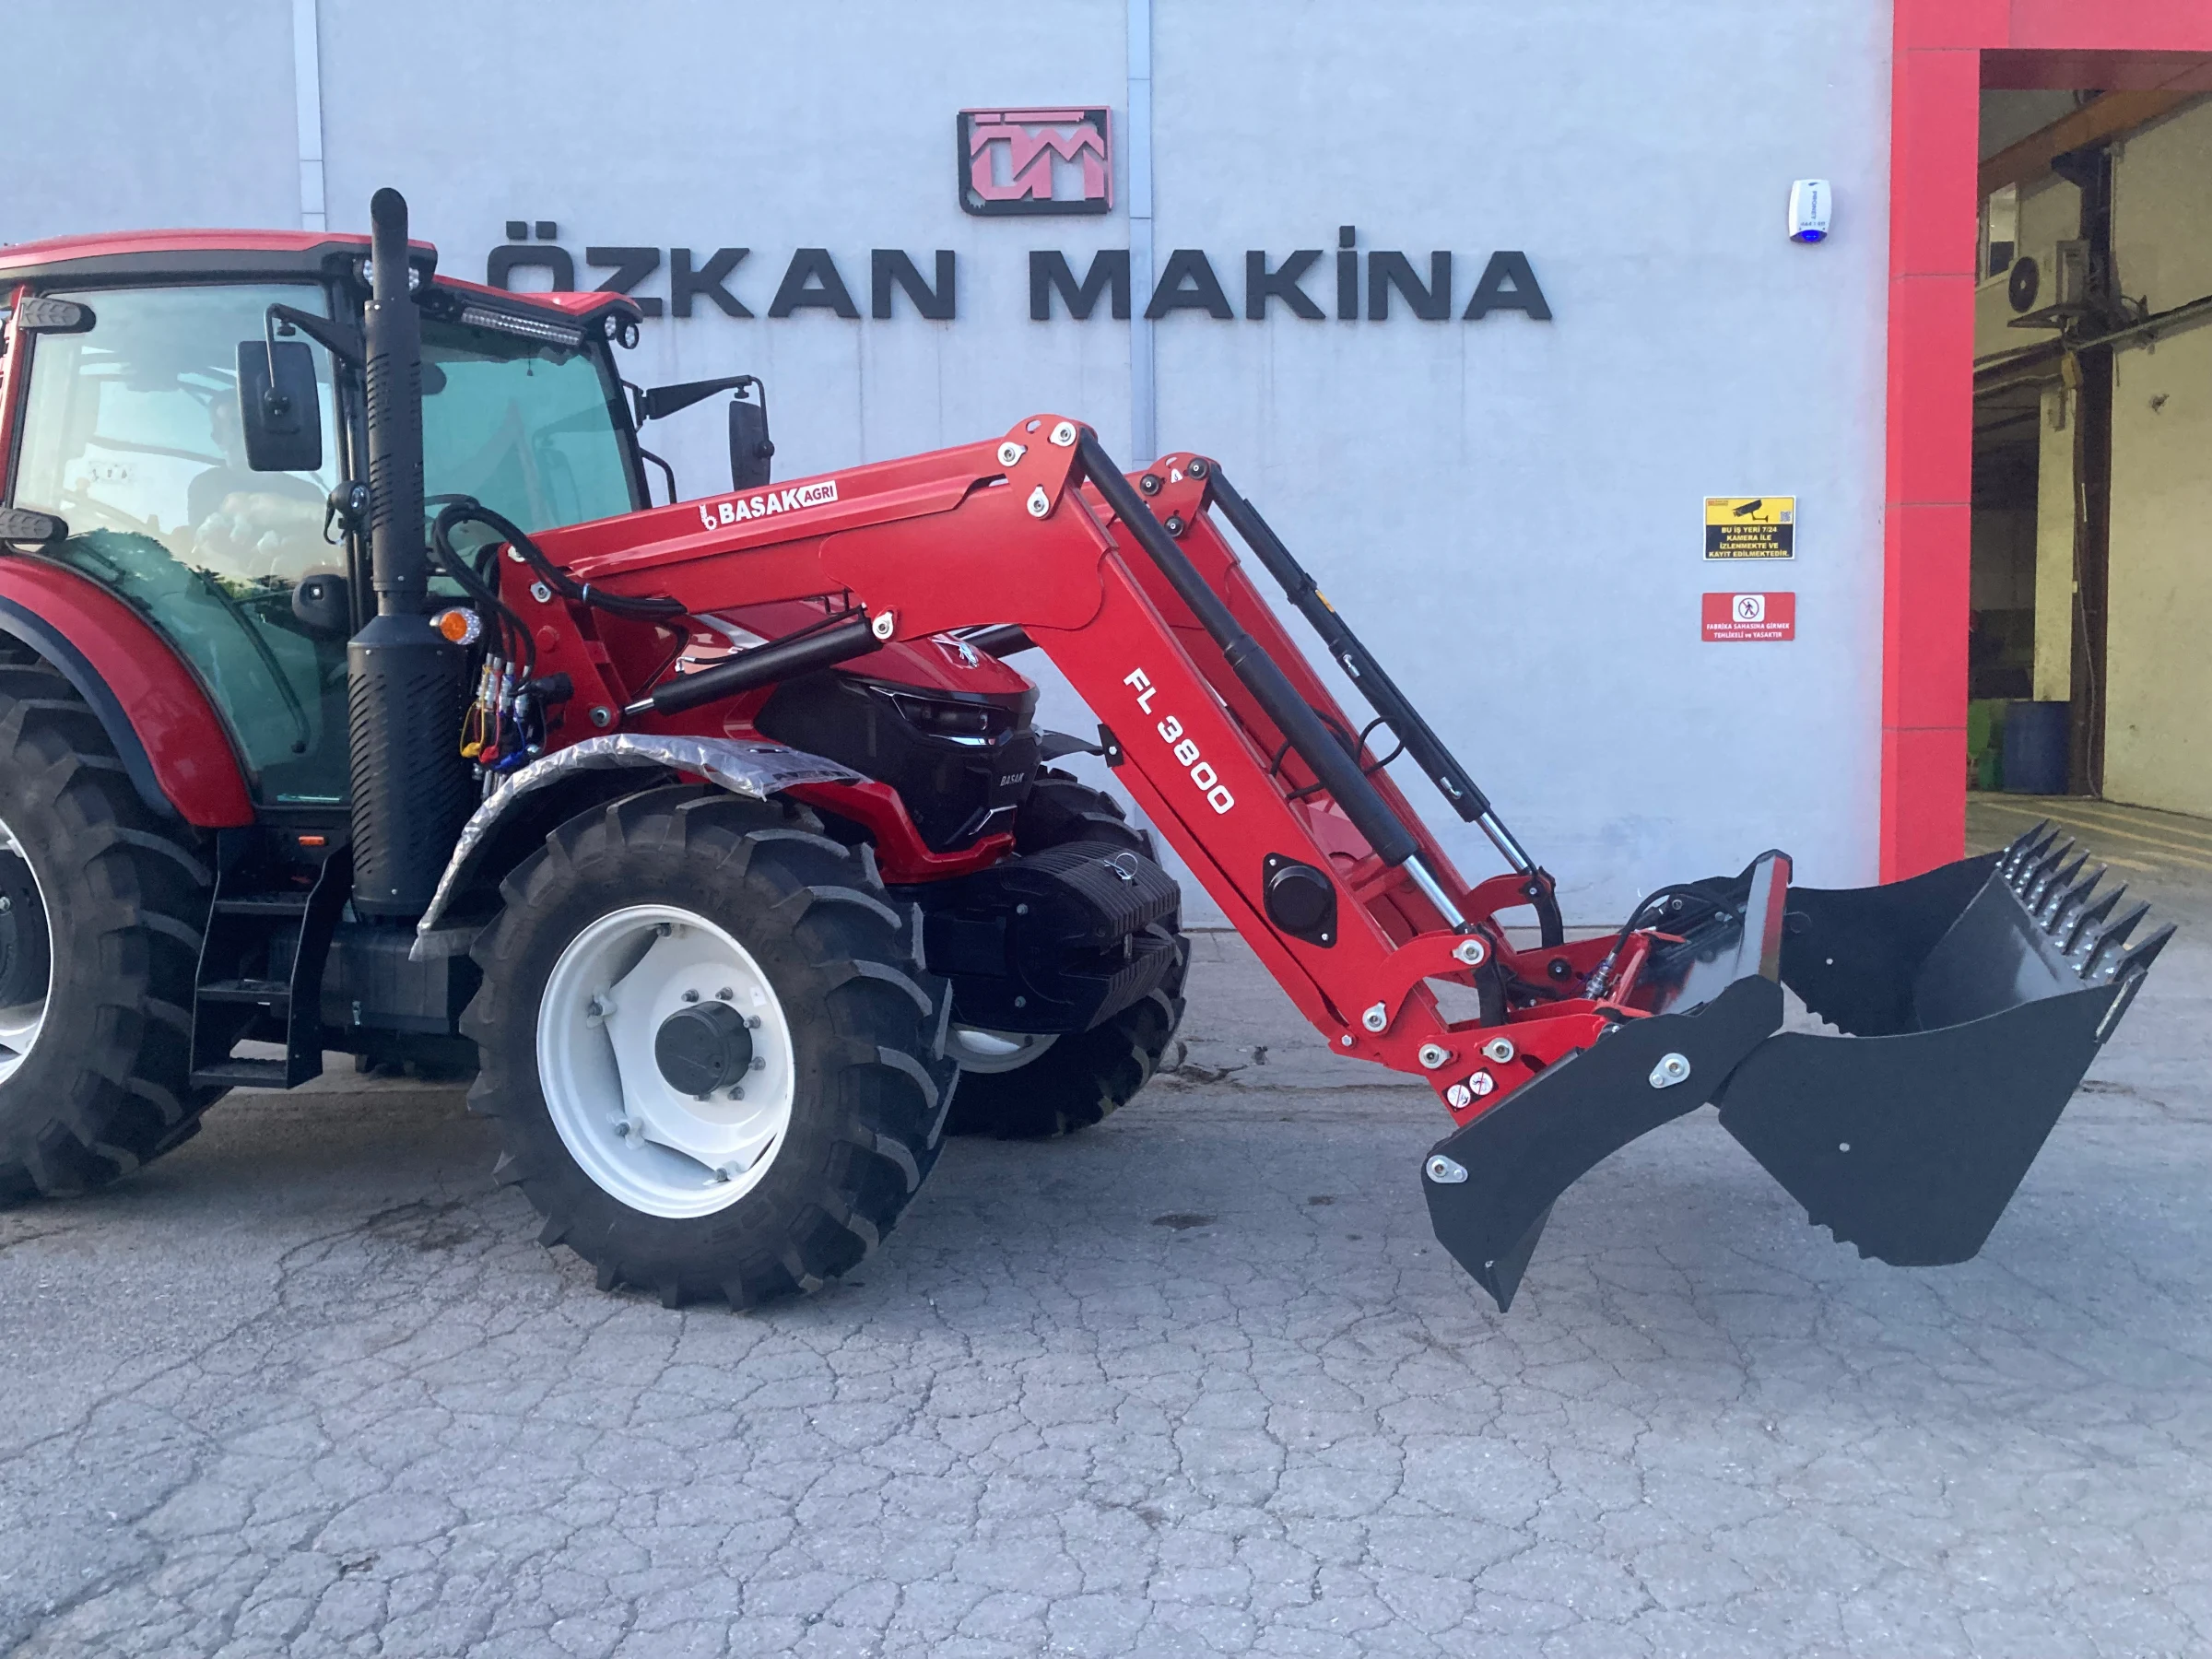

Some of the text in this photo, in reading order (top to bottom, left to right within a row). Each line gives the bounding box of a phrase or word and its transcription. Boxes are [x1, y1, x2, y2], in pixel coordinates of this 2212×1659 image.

[487, 220, 1553, 321] ÖZKAN MAKİNA
[804, 485, 835, 503] AGRI
[1734, 526, 1742, 535] İŞ
[1733, 549, 1790, 558] EDİLMEKTEDİR.
[1123, 667, 1235, 815] FL 3800
